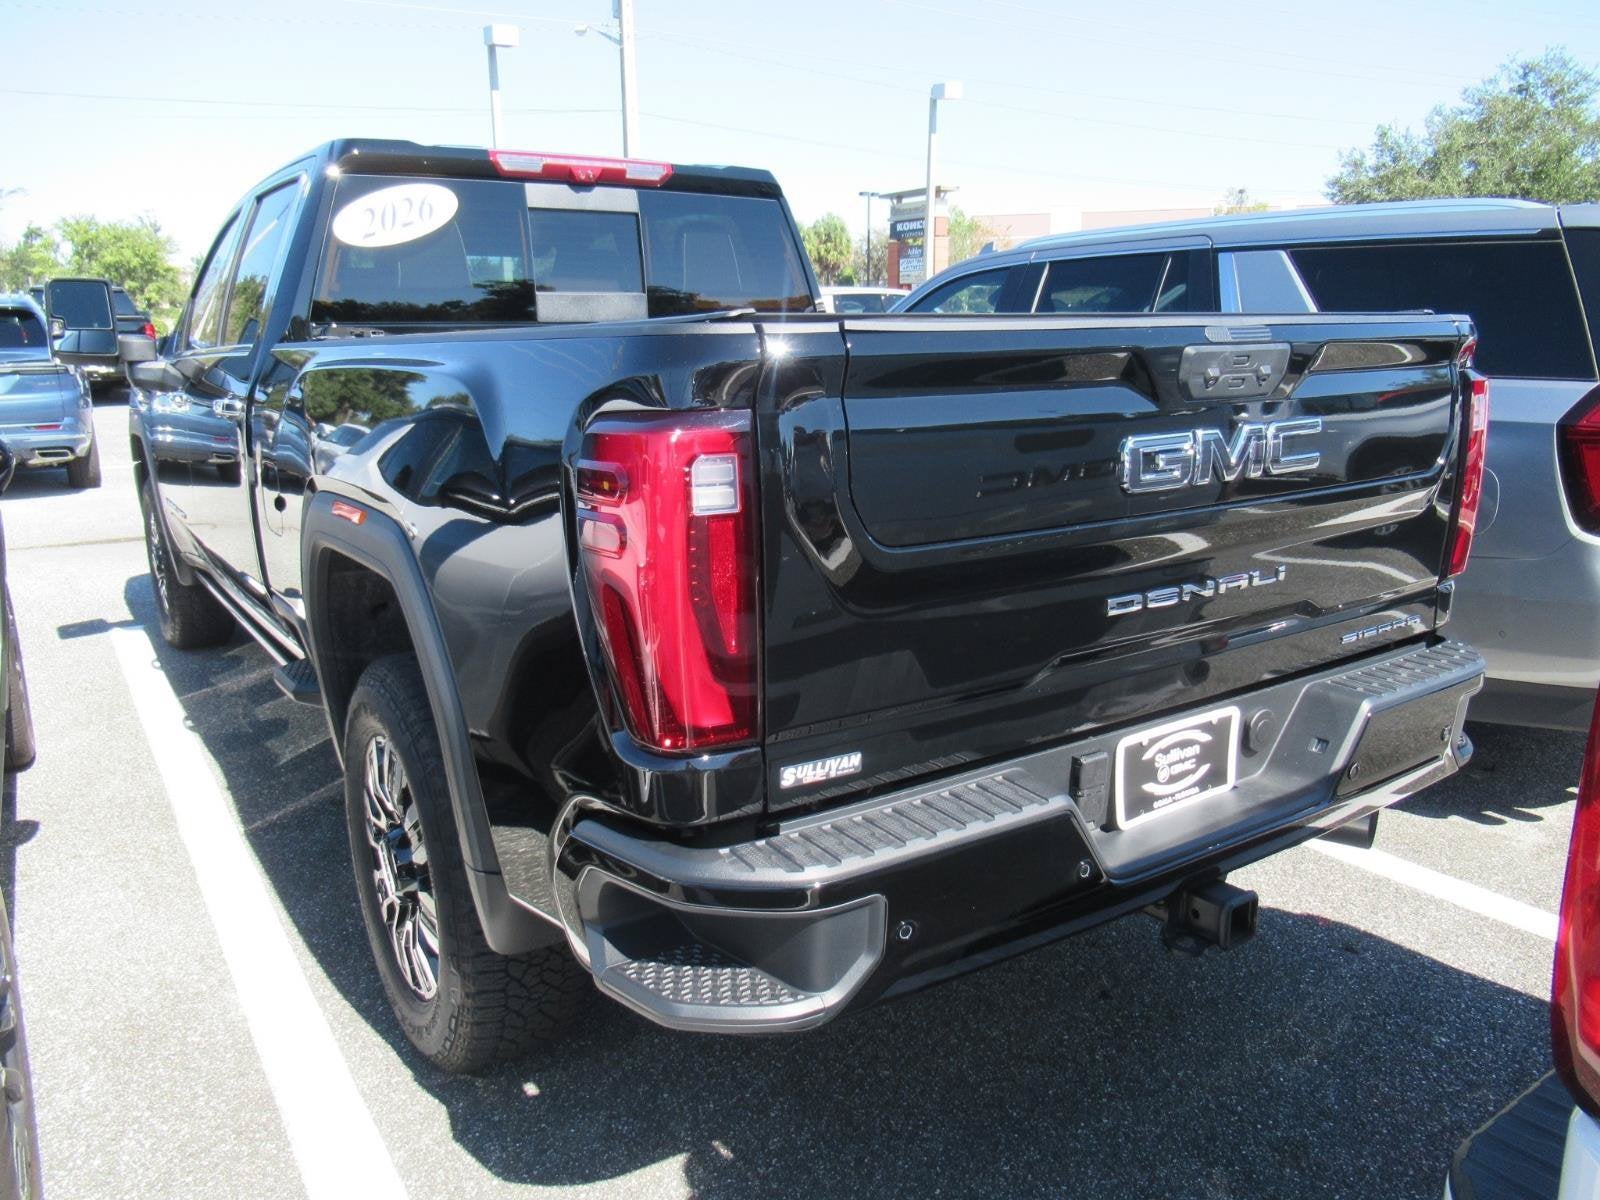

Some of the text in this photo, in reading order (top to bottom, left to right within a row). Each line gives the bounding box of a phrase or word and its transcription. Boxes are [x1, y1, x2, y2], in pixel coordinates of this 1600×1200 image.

[362, 195, 434, 240] 2026
[1119, 416, 1322, 494] GMC
[1107, 565, 1287, 617] DENALI
[1341, 615, 1422, 645] SIERRA
[780, 752, 862, 787] SULLIVAN
[1154, 744, 1201, 768] Sullivan
